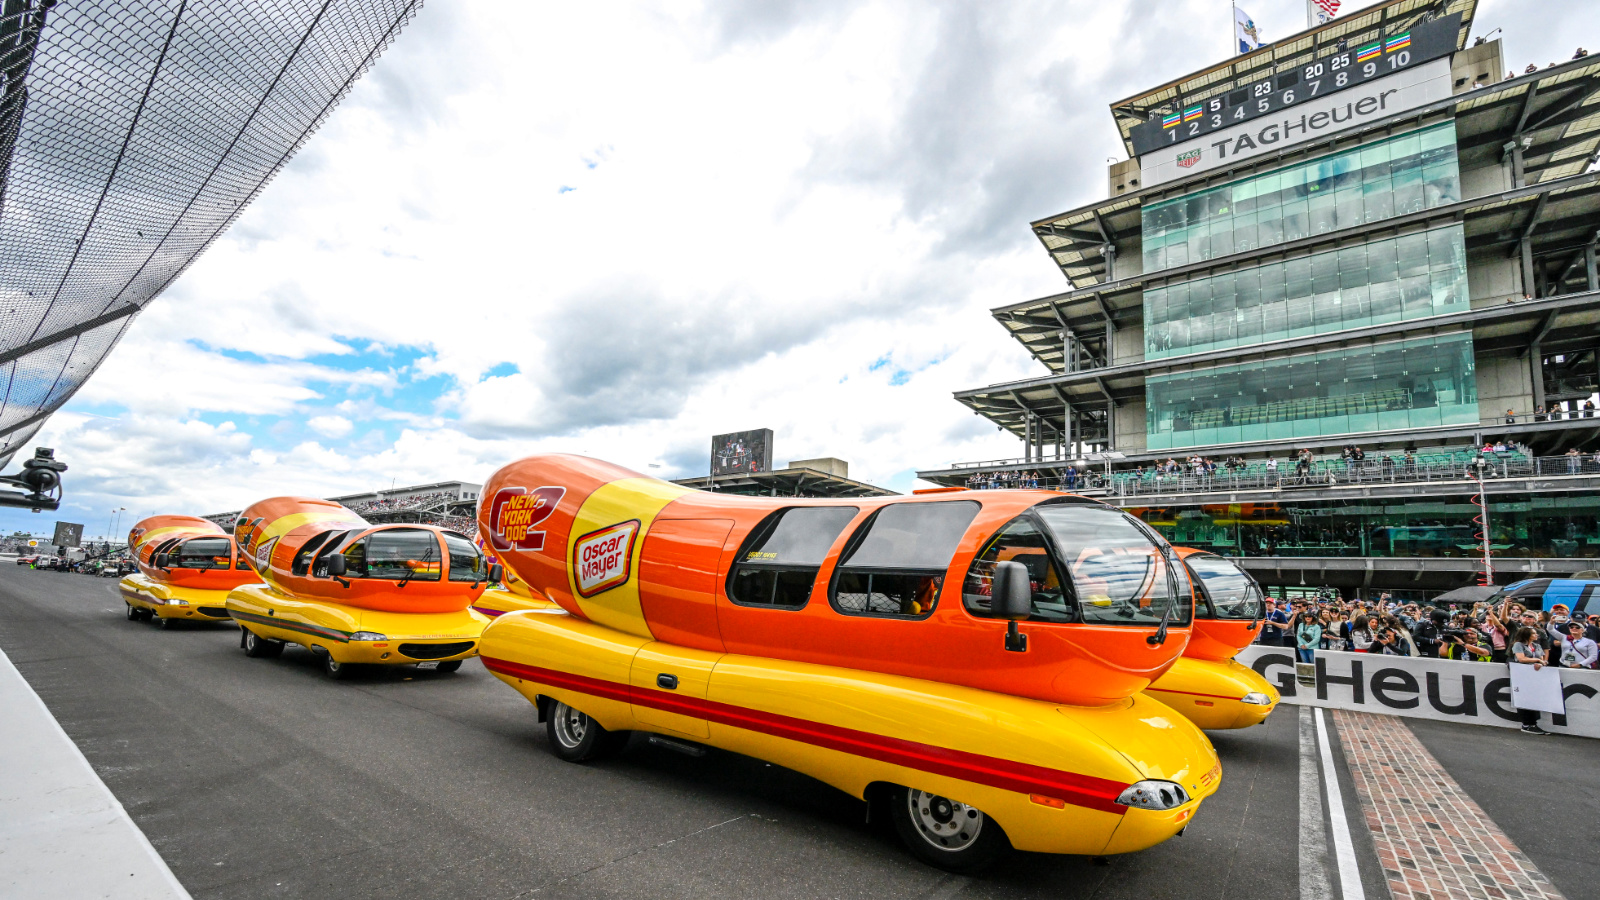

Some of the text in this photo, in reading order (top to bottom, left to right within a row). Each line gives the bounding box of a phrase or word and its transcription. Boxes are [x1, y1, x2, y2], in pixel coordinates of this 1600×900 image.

[1210, 53, 1350, 111] 5 23 20 25
[1168, 50, 1411, 142] 1 2 3 4 5 6 7 8 9 10
[507, 494, 541, 509] NEW
[504, 509, 535, 525] YORK
[505, 525, 528, 541] DOG
